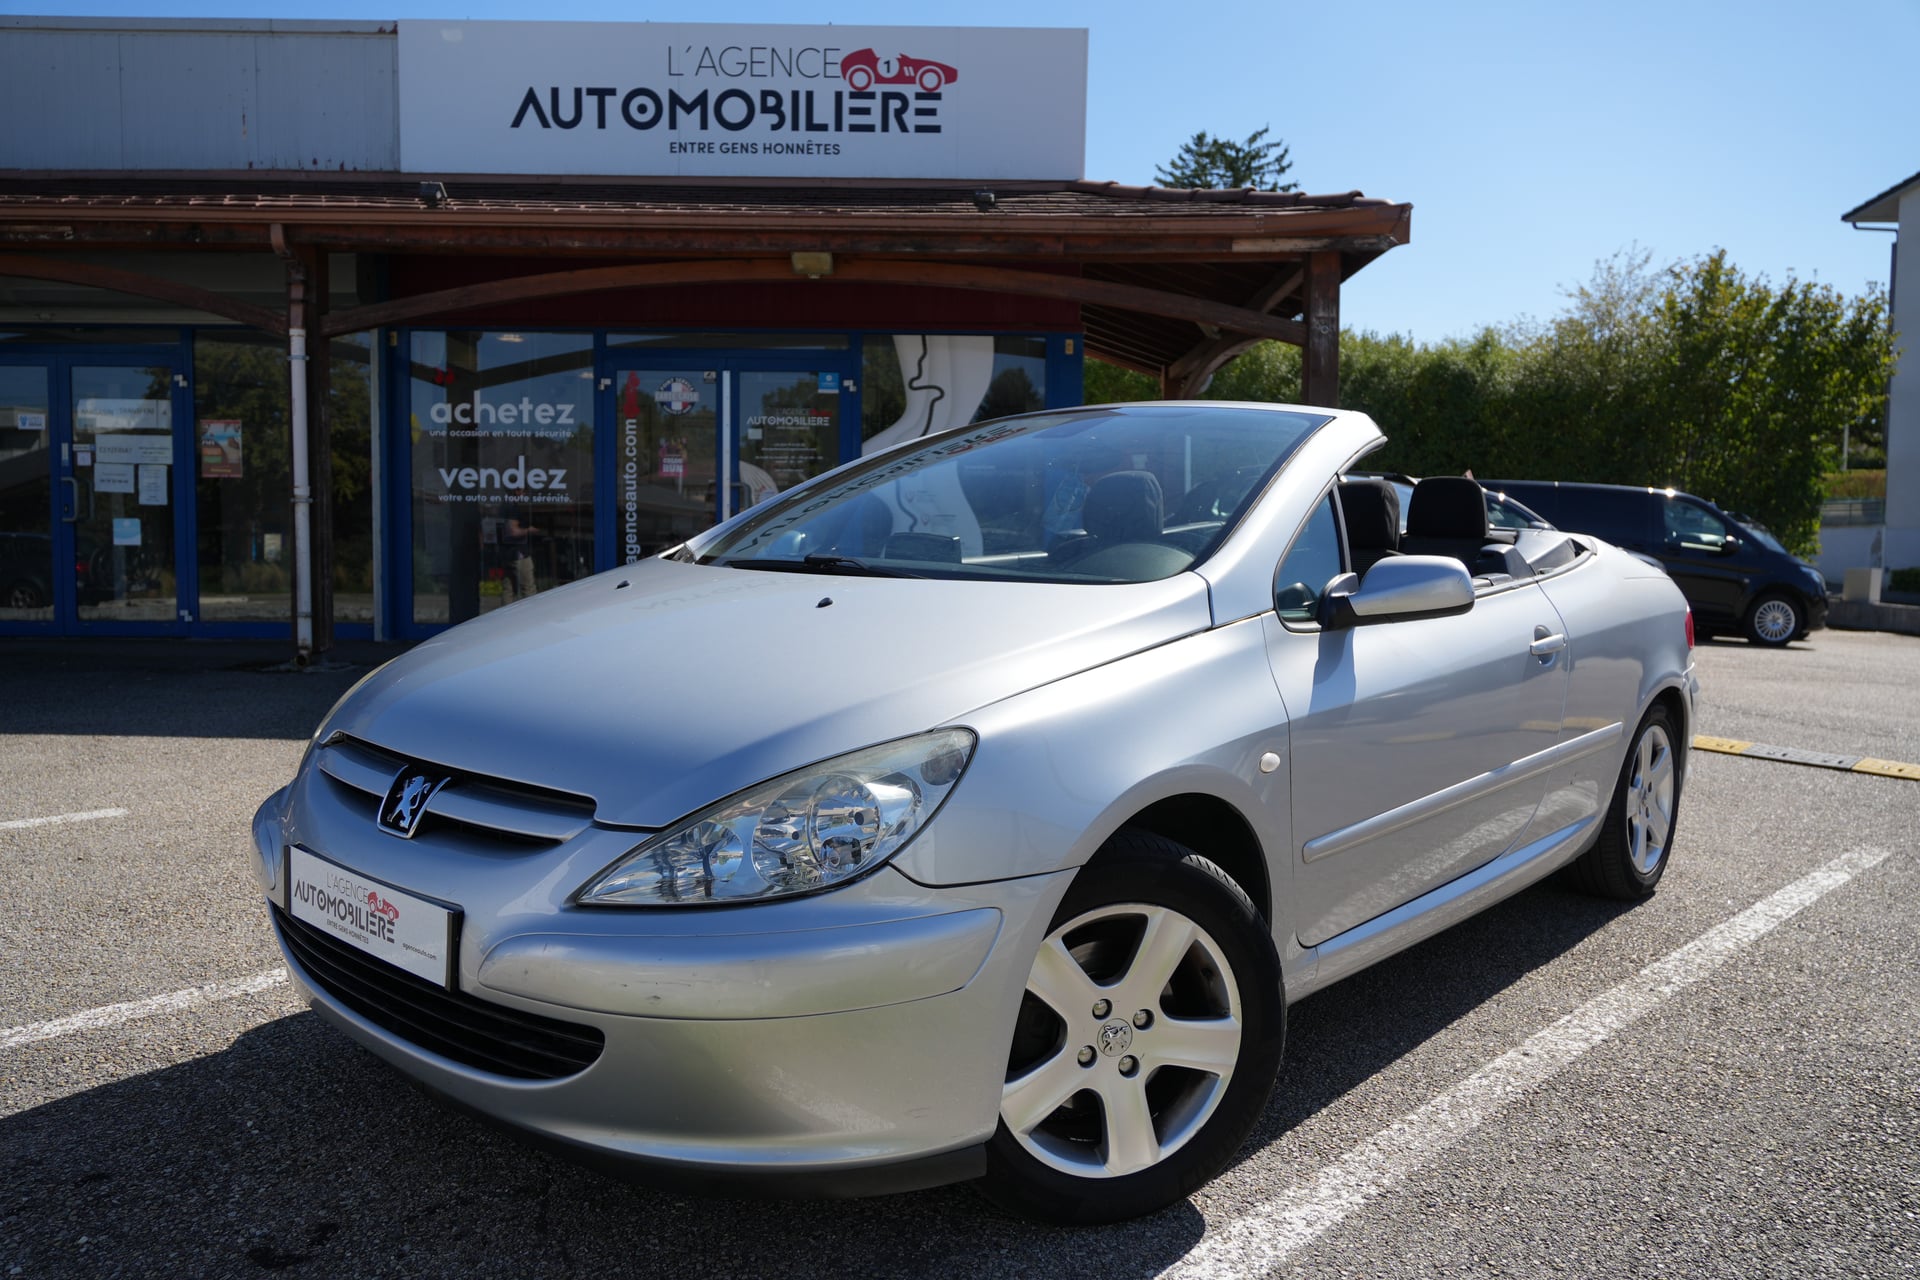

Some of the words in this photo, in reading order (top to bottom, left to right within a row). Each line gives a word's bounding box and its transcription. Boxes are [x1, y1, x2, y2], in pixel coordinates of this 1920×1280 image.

[667, 45, 841, 79] L'AGENCE
[510, 86, 942, 133] AUTOMOBILIERE
[669, 141, 715, 154] ENTRE
[720, 141, 758, 155] GENS
[763, 139, 841, 156] HONNÊTES
[430, 390, 575, 424] achetez
[450, 429, 489, 437] occasion
[507, 429, 531, 438] toute
[438, 455, 567, 489] vendez
[438, 494, 462, 502] votre
[465, 494, 487, 502] auto
[504, 494, 529, 502] toute
[624, 419, 640, 564] agenceauto.com
[326, 871, 368, 905] L'AGENCE
[294, 879, 395, 944] AUTOMOBILIERE
